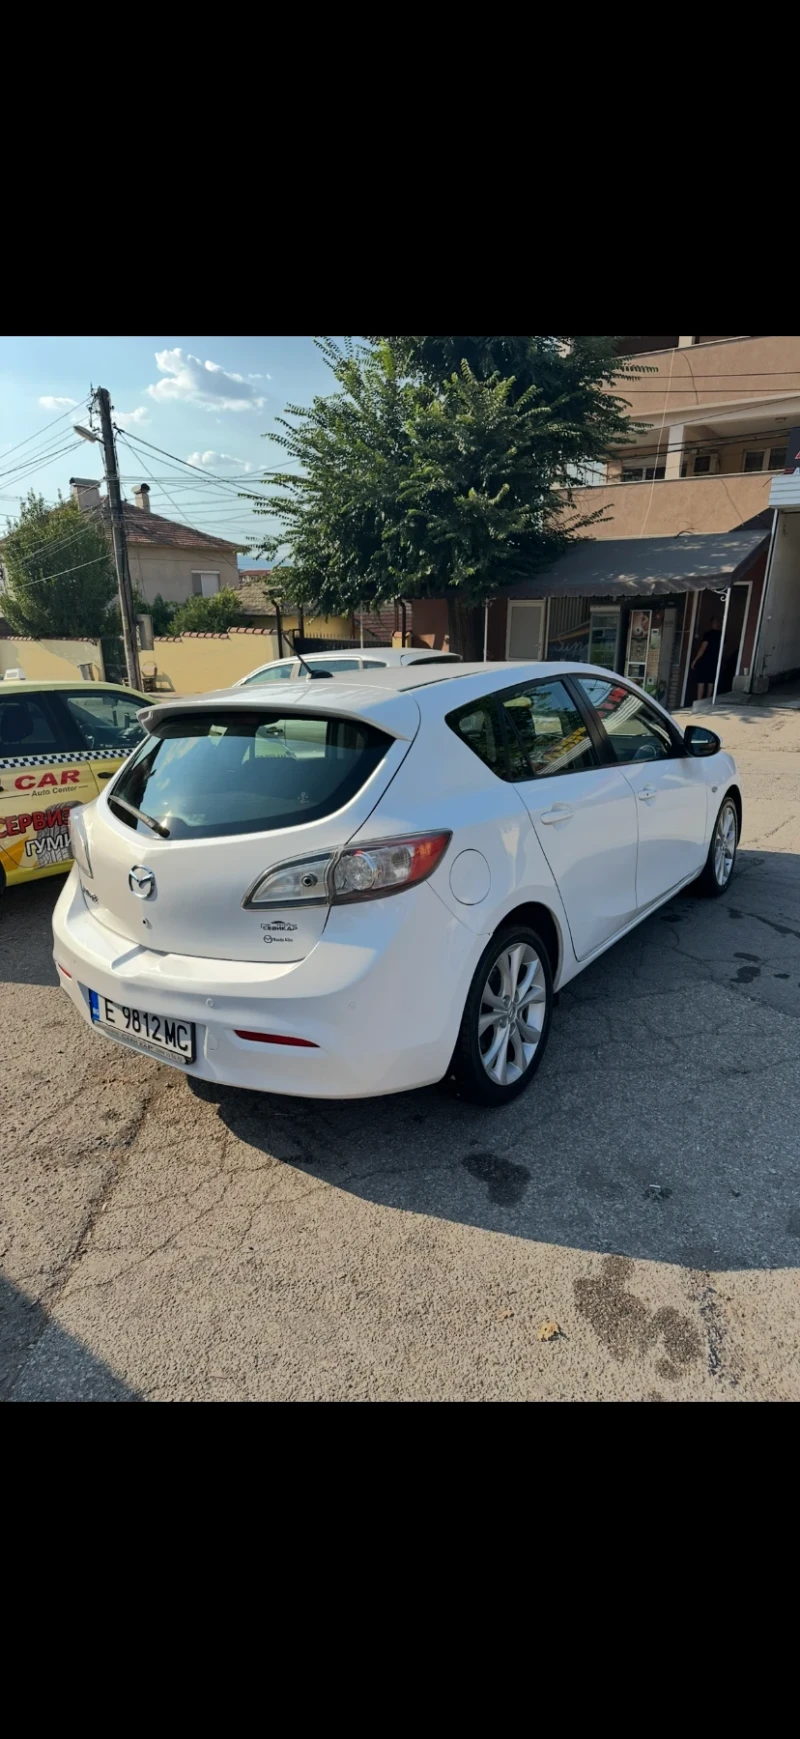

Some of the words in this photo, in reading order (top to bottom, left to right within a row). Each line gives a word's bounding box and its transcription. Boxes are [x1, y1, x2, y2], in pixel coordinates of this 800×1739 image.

[14, 769, 80, 791] CAR
[31, 789, 50, 797] Auto
[52, 785, 77, 794] Center
[104, 998, 116, 1024] E
